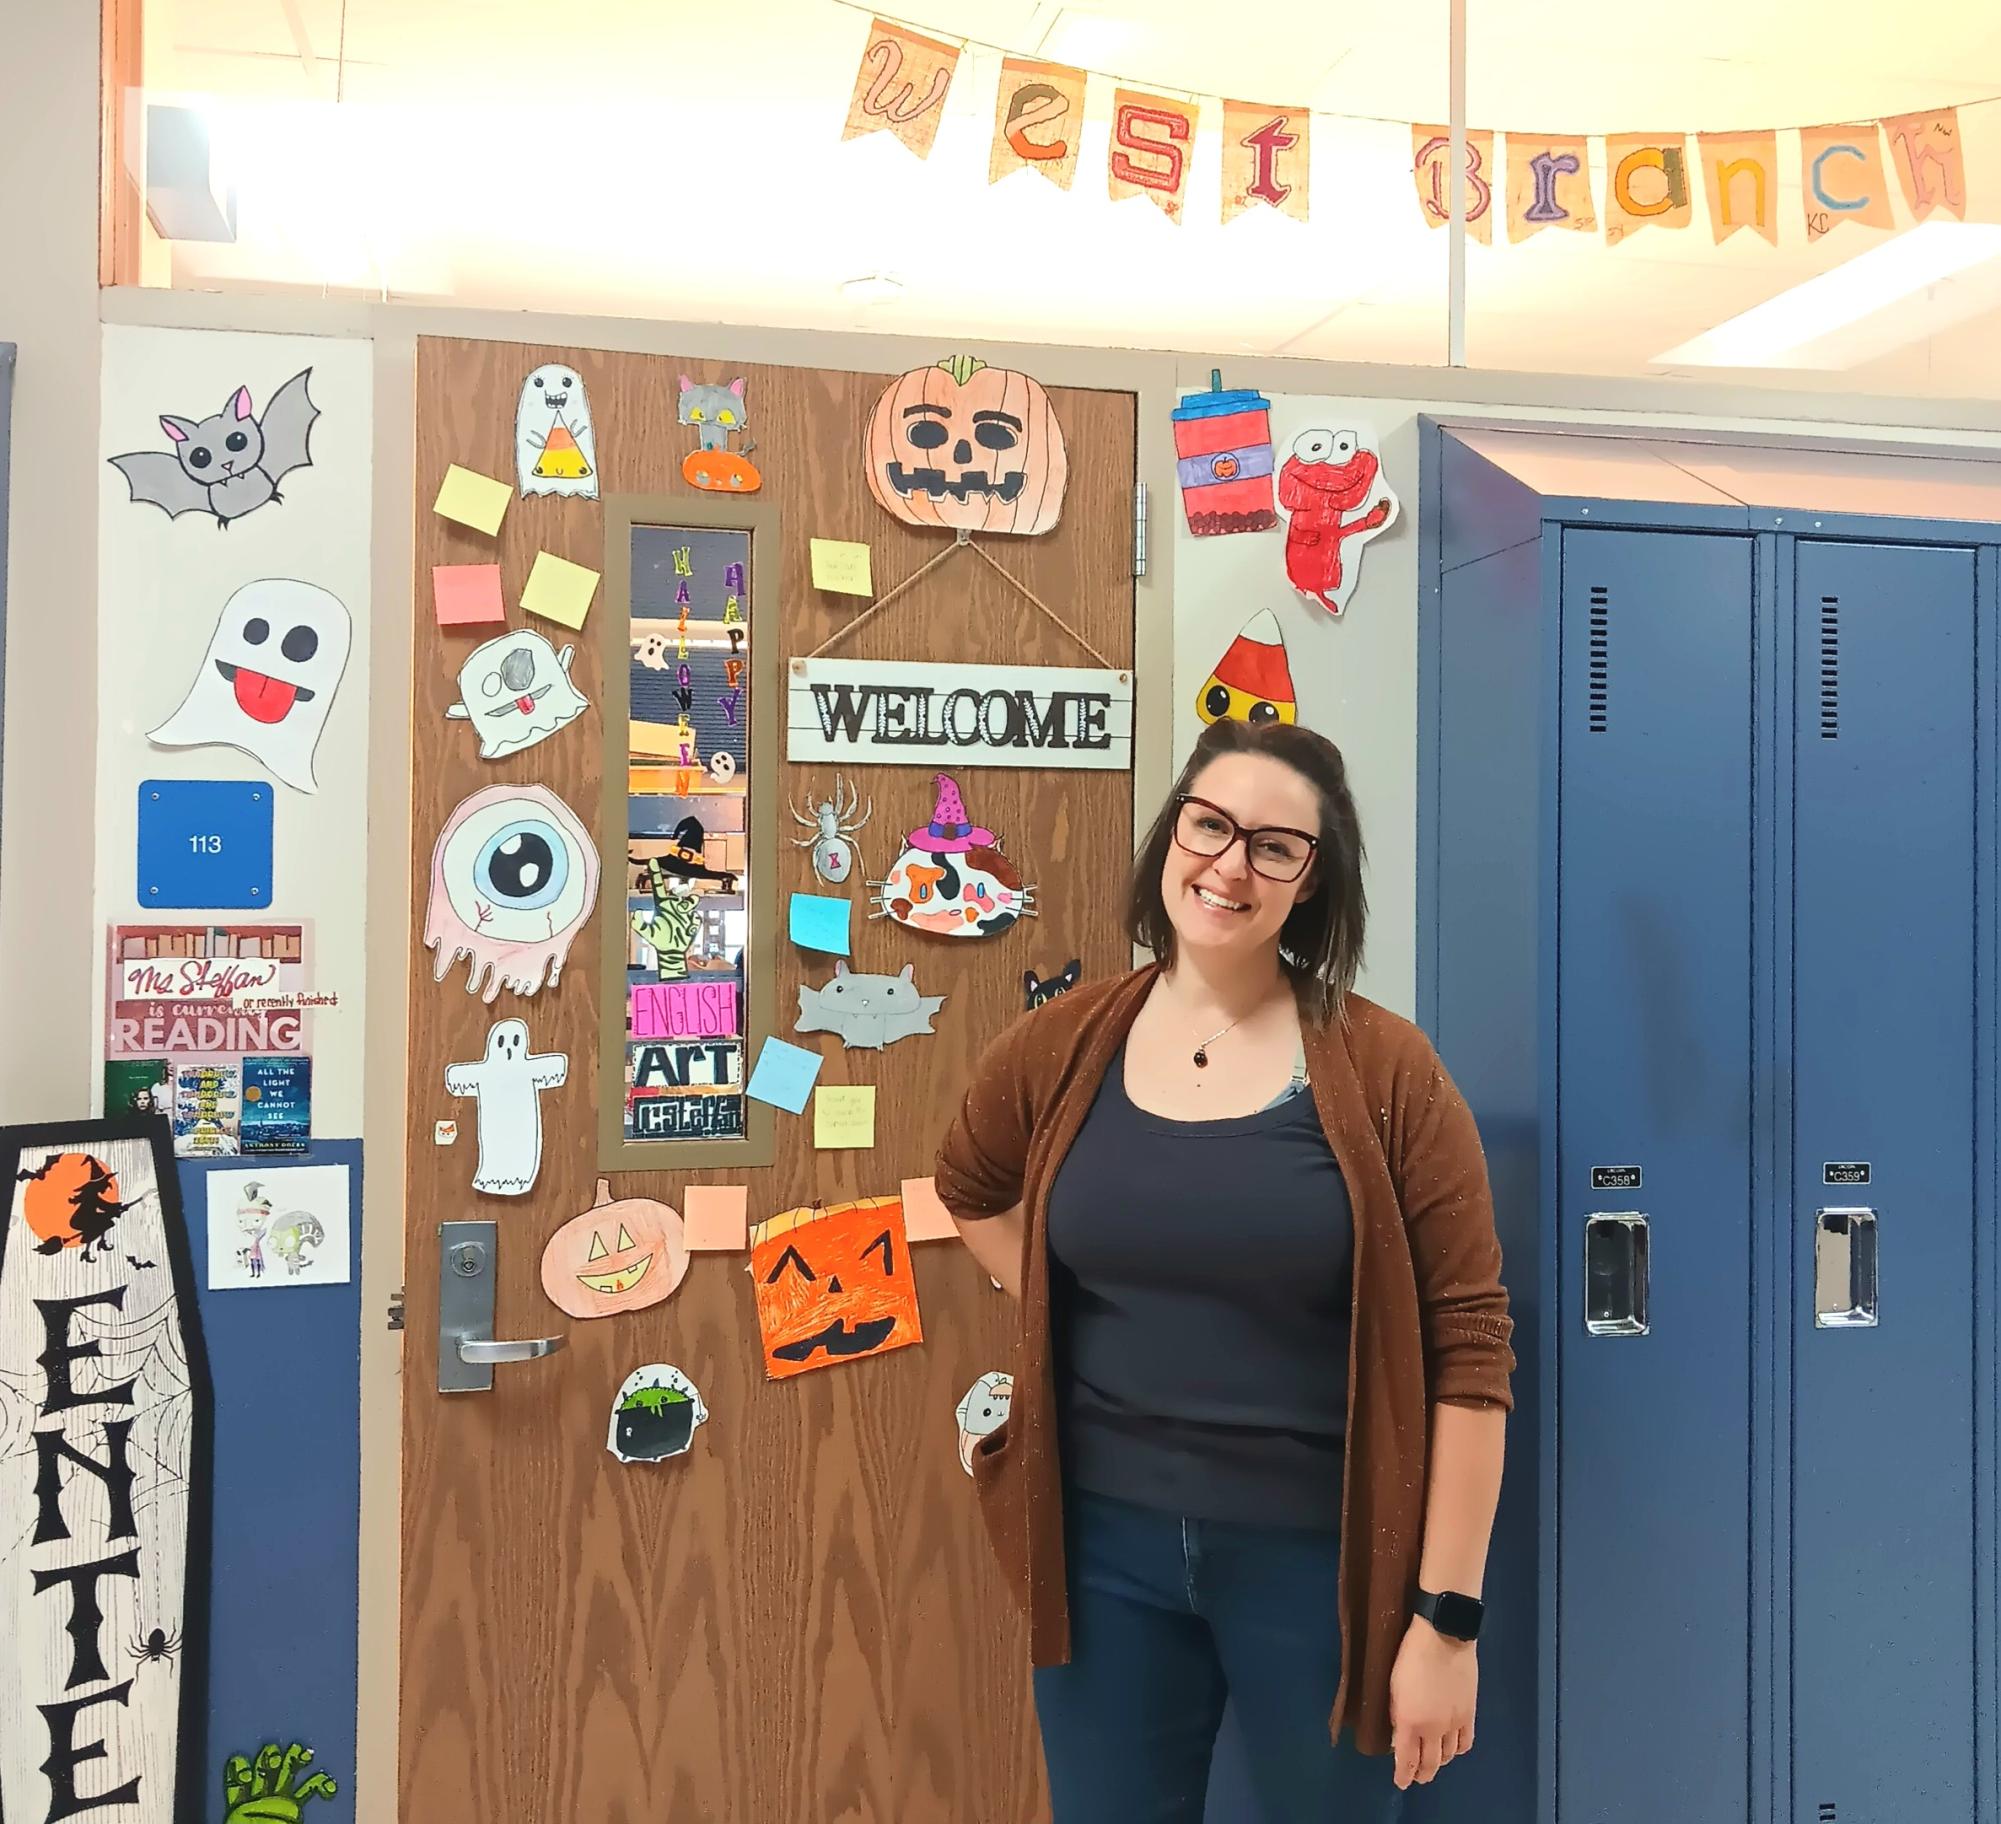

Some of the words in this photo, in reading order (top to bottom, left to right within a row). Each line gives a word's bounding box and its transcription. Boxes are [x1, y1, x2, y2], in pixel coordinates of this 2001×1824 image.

[866, 39, 1299, 206] West
[1415, 122, 1962, 226] Branch
[717, 561, 746, 726] HAPPY
[672, 546, 693, 799] HALLOWEEN
[810, 683, 1111, 749] WELCOME
[188, 835, 222, 854] 113
[179, 960, 277, 998] Steffan
[243, 998, 254, 1009] or
[256, 994, 294, 1008] recently
[296, 991, 338, 1007] finished
[150, 1002, 164, 1017] is
[635, 984, 735, 1036] ENGLISH
[114, 1016, 301, 1051] READING
[257, 1068, 274, 1076] ALL
[277, 1068, 295, 1076] THE
[263, 1079, 291, 1087] LIGHT
[269, 1090, 284, 1098] WE
[257, 1101, 296, 1109] CANNOT
[267, 1112, 284, 1120] SEE
[1603, 1175, 1630, 1186] C358
[1834, 1171, 1860, 1181] C359
